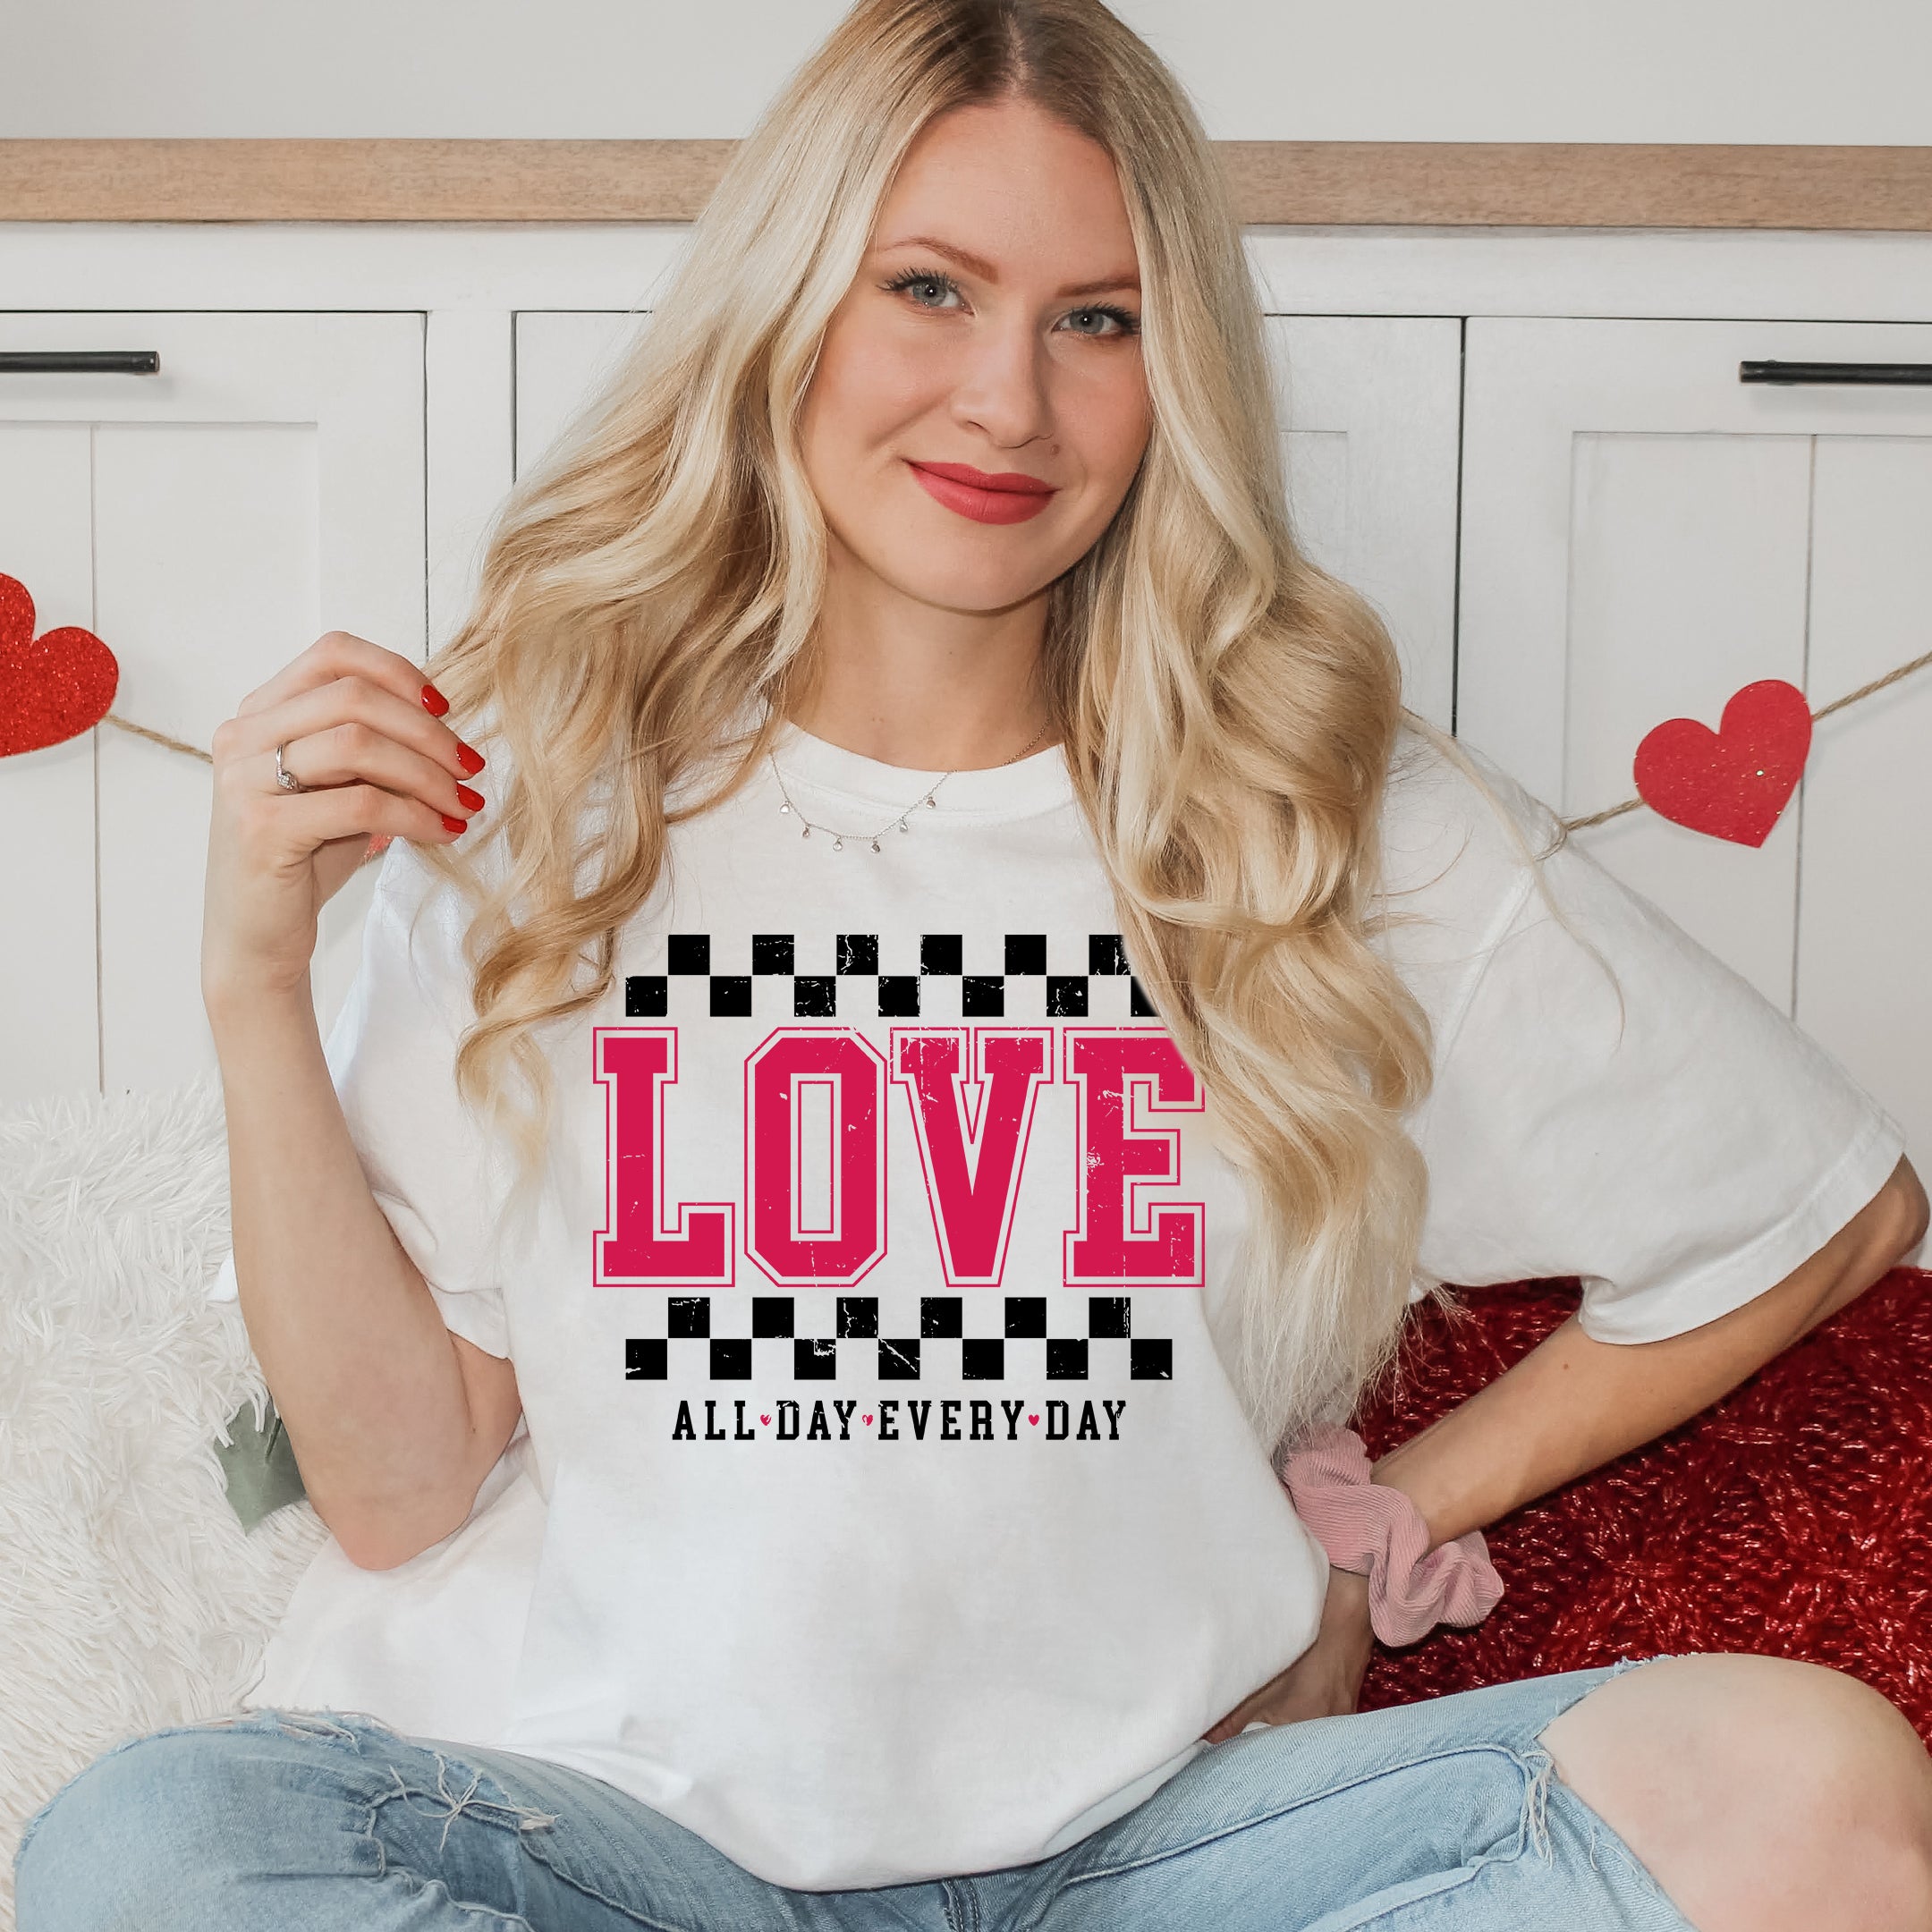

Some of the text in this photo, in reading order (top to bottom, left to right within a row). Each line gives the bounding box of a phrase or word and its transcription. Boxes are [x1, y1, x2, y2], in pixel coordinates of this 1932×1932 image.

[593, 1027, 1205, 1287] LOVE
[672, 1400, 1127, 1441] ALL DAY EVERY DAY
